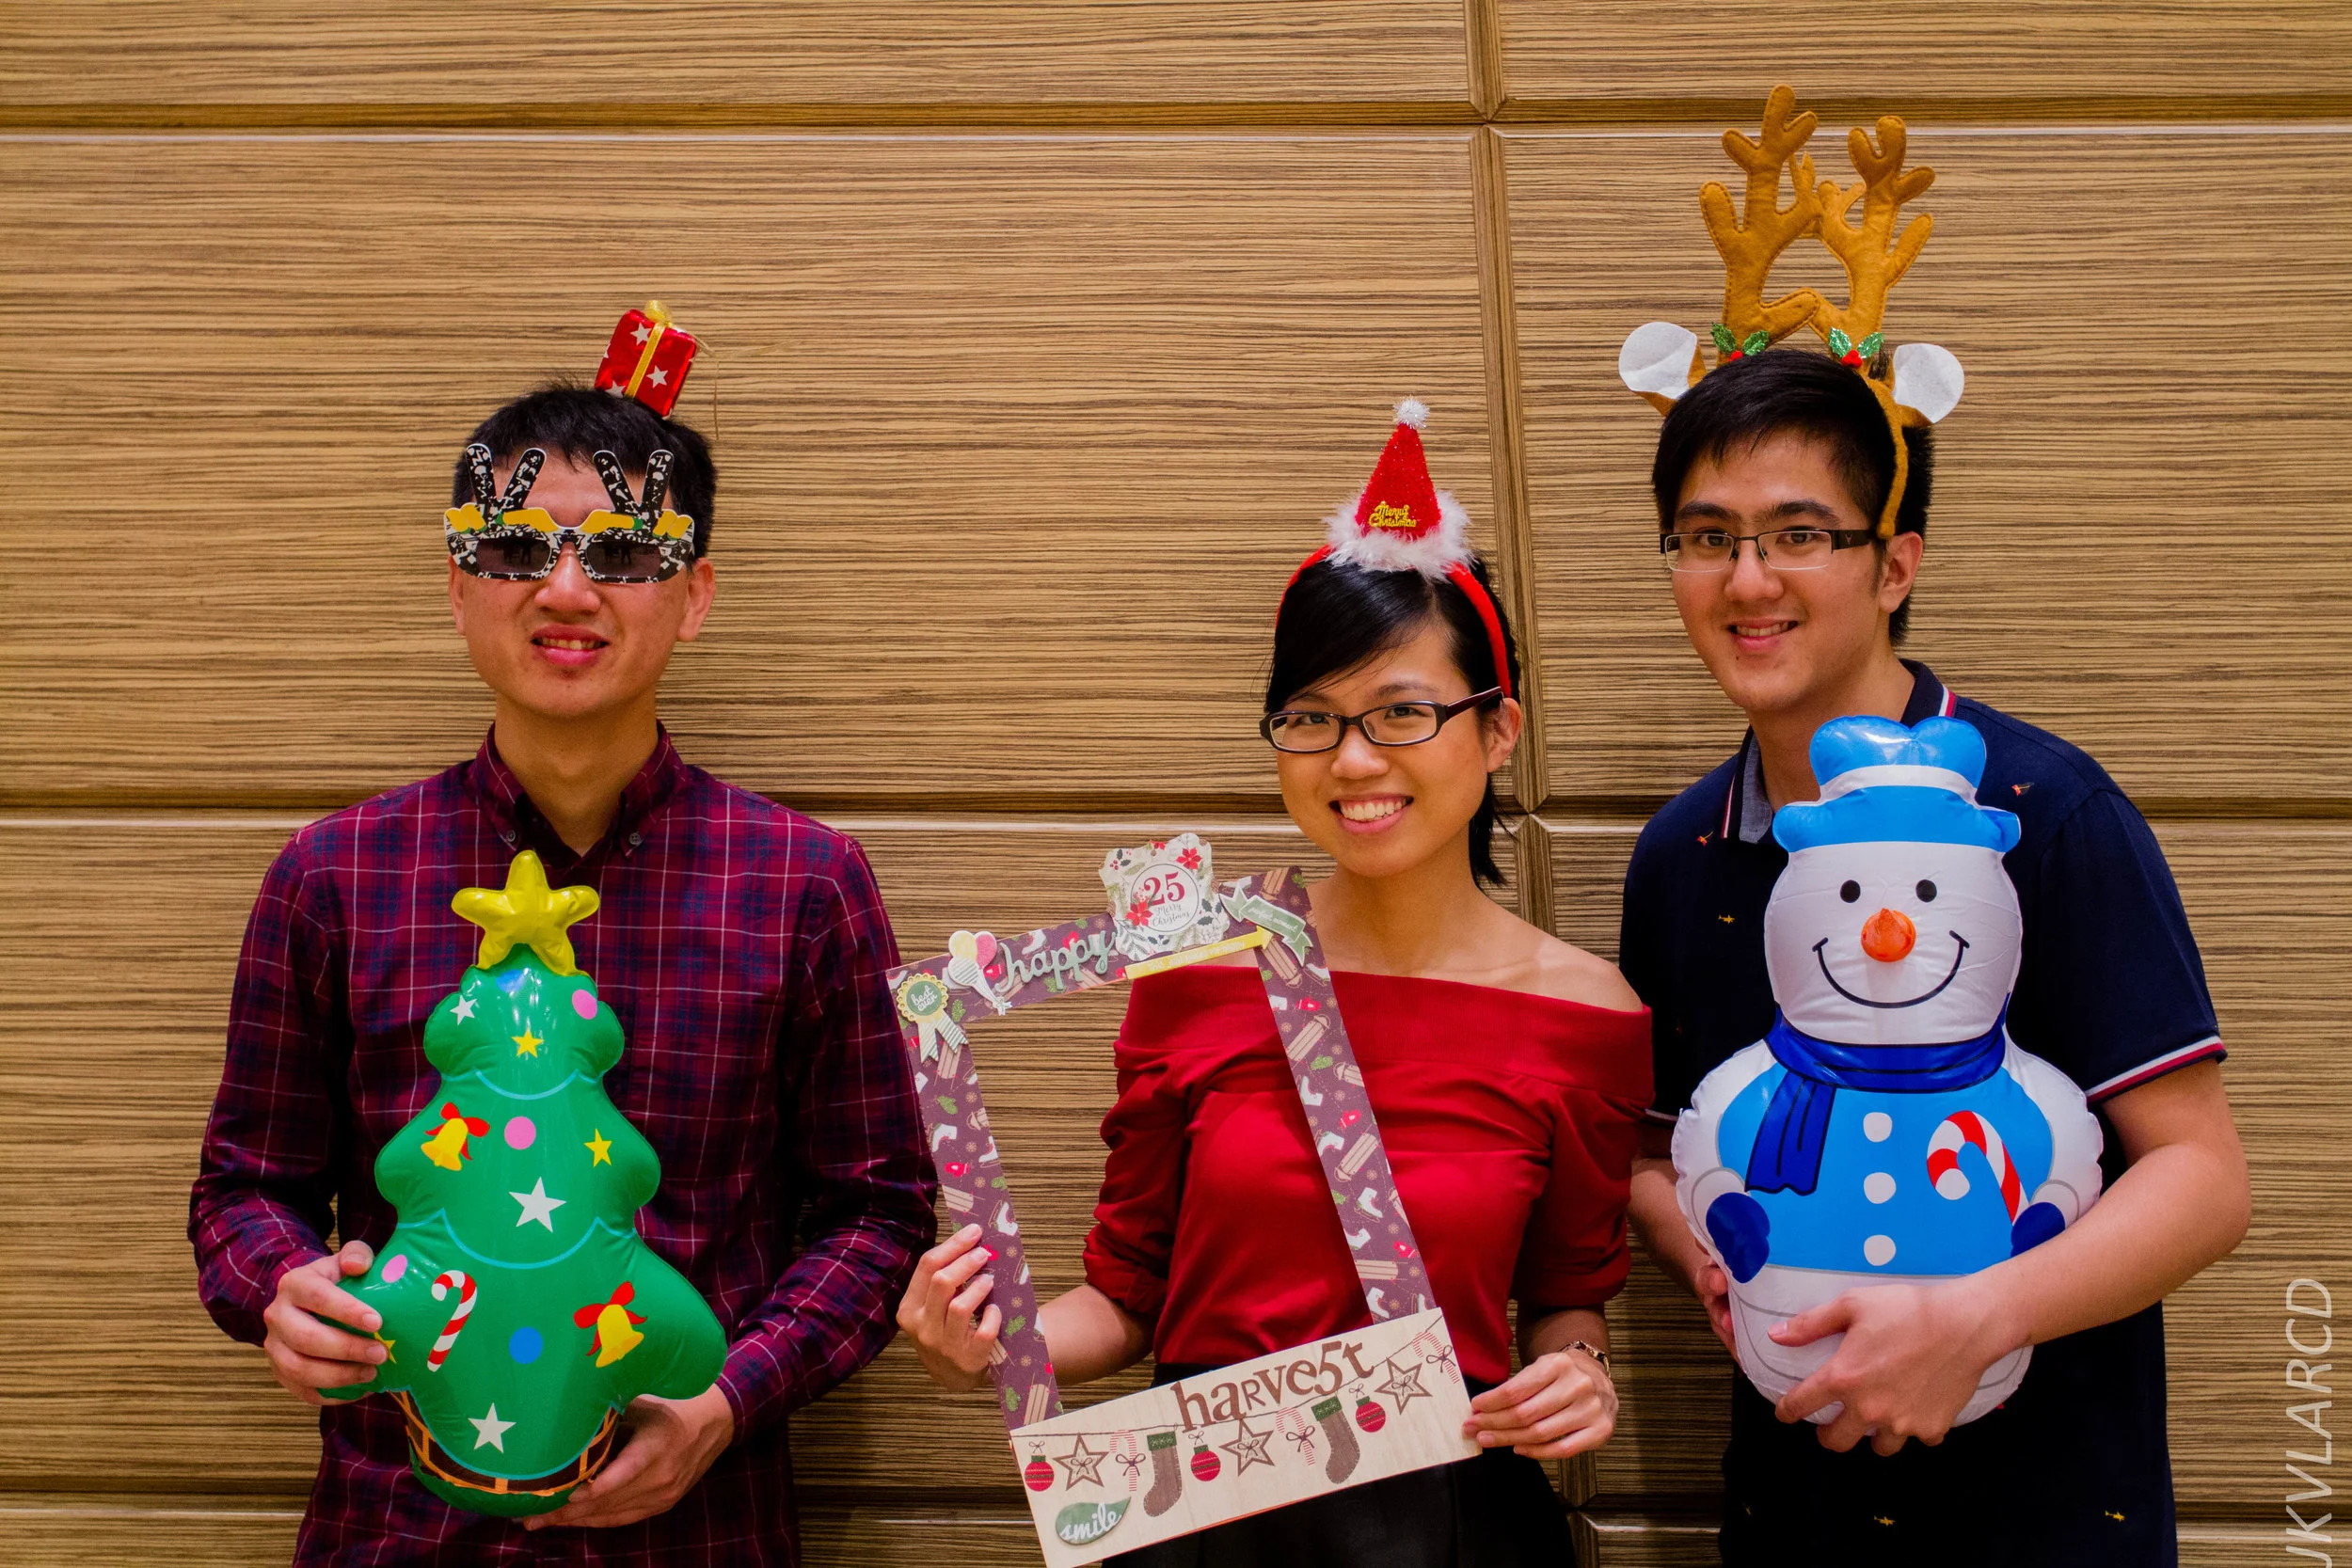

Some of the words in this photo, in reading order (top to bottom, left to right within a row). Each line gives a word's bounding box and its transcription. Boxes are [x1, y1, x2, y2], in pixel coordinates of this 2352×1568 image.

[1143, 871, 1185, 907] 25
[1152, 911, 1191, 927] Christmas
[1155, 903, 1183, 916] Merry
[994, 930, 1117, 992] happy
[911, 985, 934, 1006] best
[1059, 1502, 1123, 1541] smile
